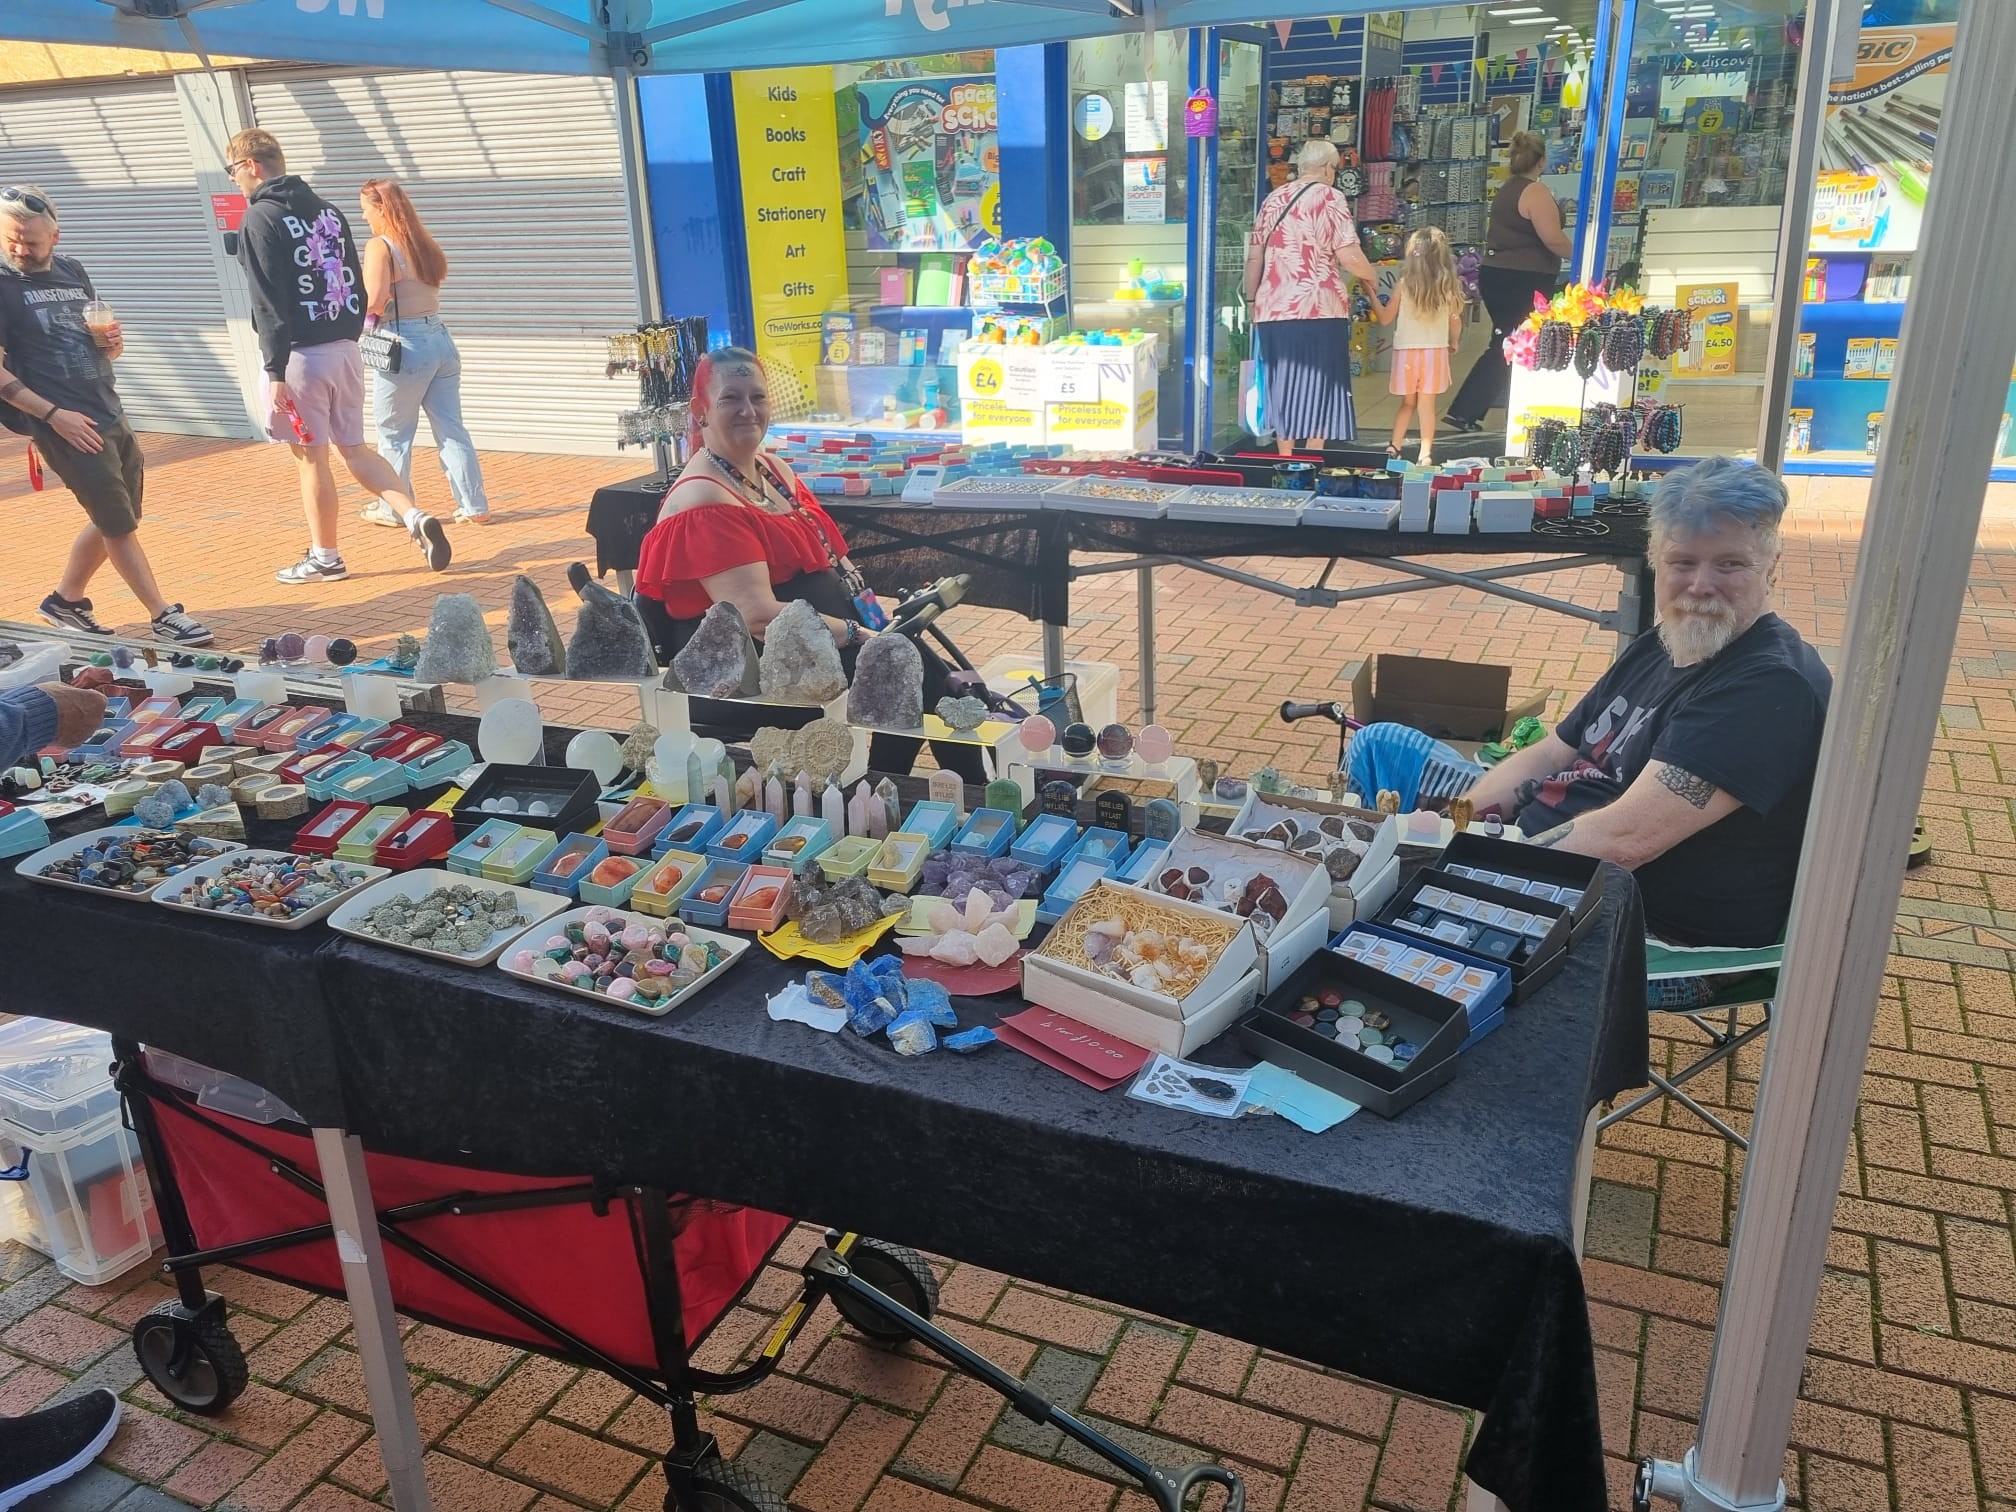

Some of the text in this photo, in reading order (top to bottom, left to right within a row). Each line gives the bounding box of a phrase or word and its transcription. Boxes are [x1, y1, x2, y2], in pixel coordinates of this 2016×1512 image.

[1828, 93, 1839, 102] he
[1841, 88, 1879, 102] nation's
[1880, 59, 1936, 91] best-selling
[768, 86, 797, 101] Kids
[1703, 117, 1718, 127] £7
[765, 127, 806, 142] Books
[771, 166, 806, 182] Craft
[757, 206, 826, 222] Stationery
[294, 237, 346, 268] GET
[785, 244, 806, 258] Art
[298, 266, 355, 294] SAD
[783, 281, 814, 297] Gifts
[1706, 338, 1733, 348] £4.50
[833, 348, 845, 360] £1
[976, 372, 997, 388] £4
[1060, 382, 1075, 393] £5
[1059, 403, 1121, 415] Priceless fun
[973, 412, 1031, 424] for everyone
[1059, 416, 1121, 427] for everyone
[1100, 800, 1124, 810] HERE LIES
[1109, 812, 1122, 820] LAST
